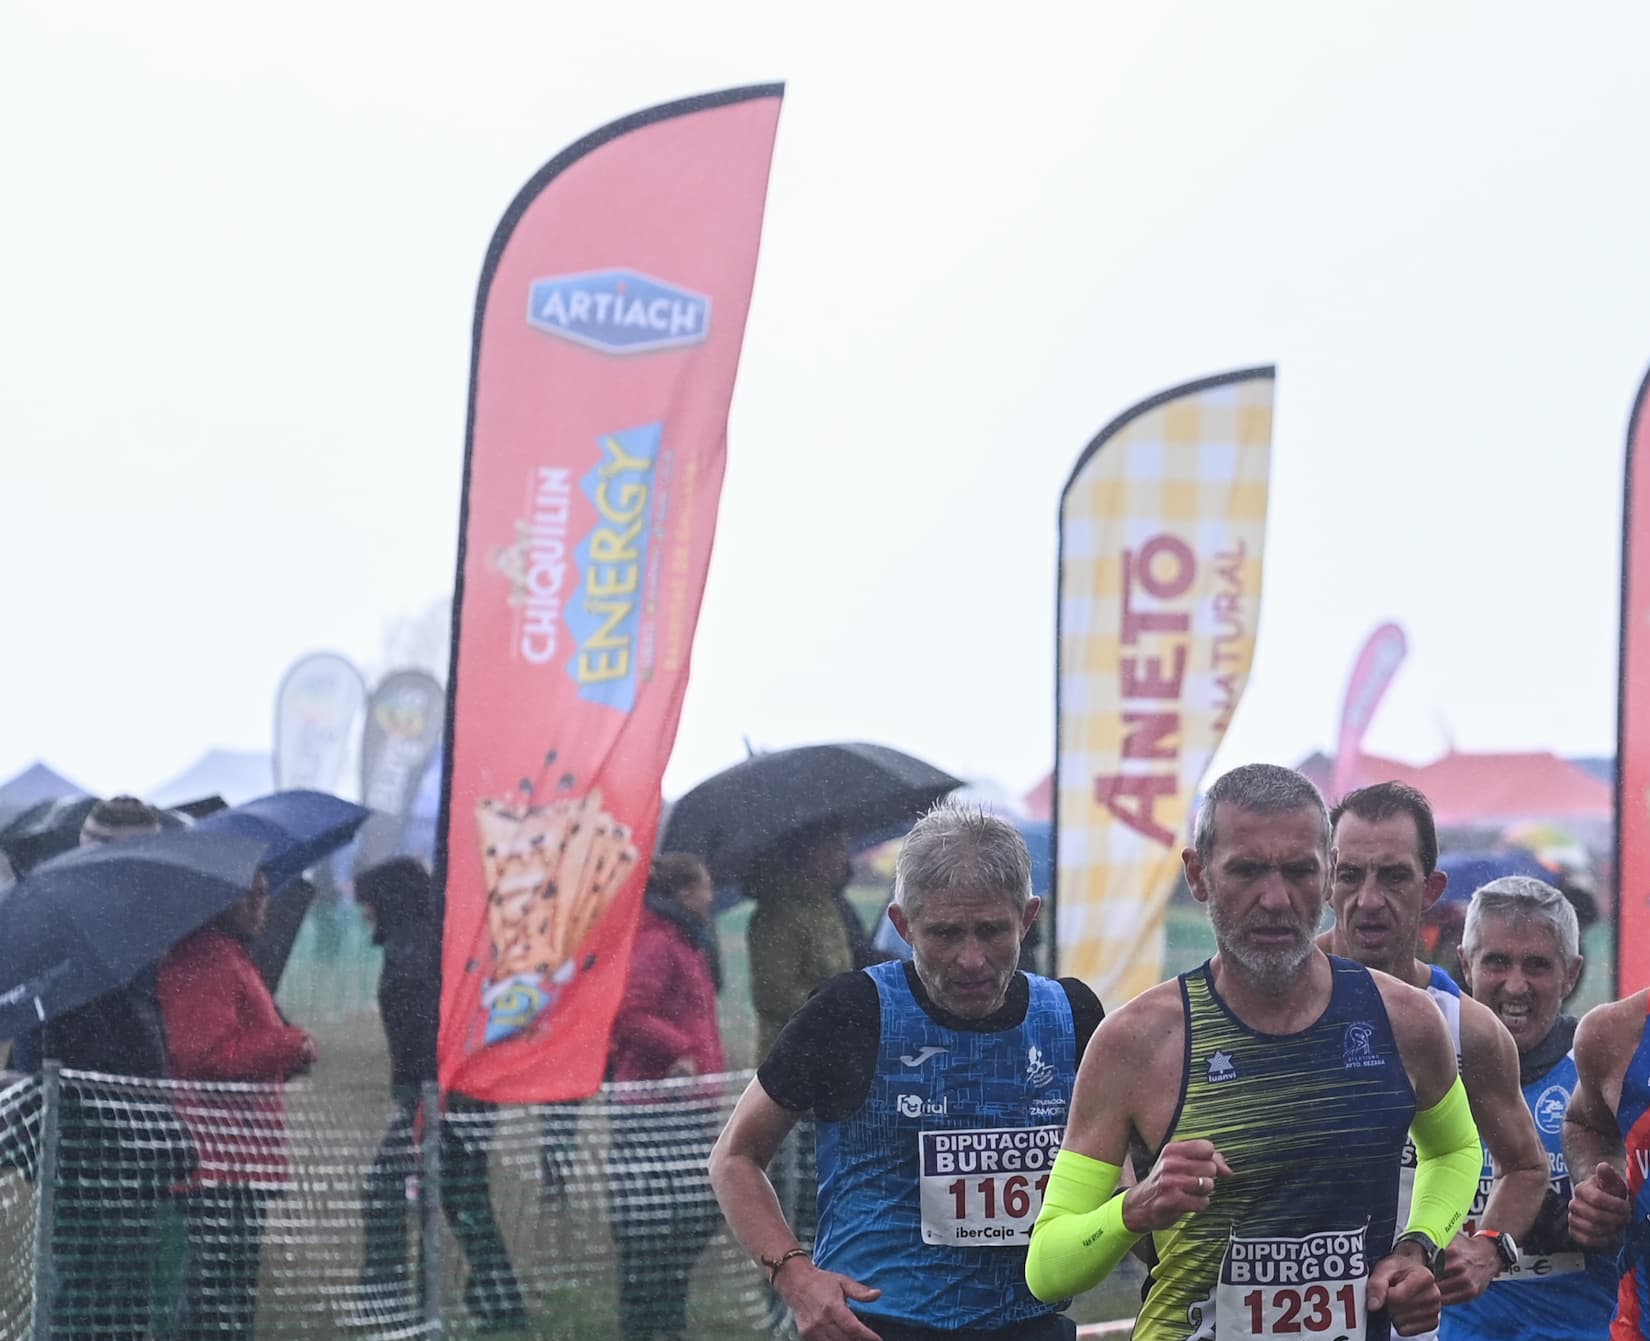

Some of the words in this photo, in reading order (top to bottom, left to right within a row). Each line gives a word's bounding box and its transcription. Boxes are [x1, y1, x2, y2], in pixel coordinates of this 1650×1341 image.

[541, 291, 700, 335] ARTIACH
[522, 467, 571, 664] CHIQUILIN
[578, 437, 655, 683] ENERGY
[1093, 532, 1197, 849] ANETO
[1208, 1070, 1237, 1082] luanvi
[935, 1129, 1059, 1151] DIPUTACIÓN
[936, 1147, 1057, 1173] BURGOS
[956, 1226, 1015, 1240] iberCaja
[1231, 1234, 1363, 1260] DIPUTACIÓN
[1231, 1253, 1365, 1282] BURGOS
[1244, 1284, 1357, 1335] 1231
